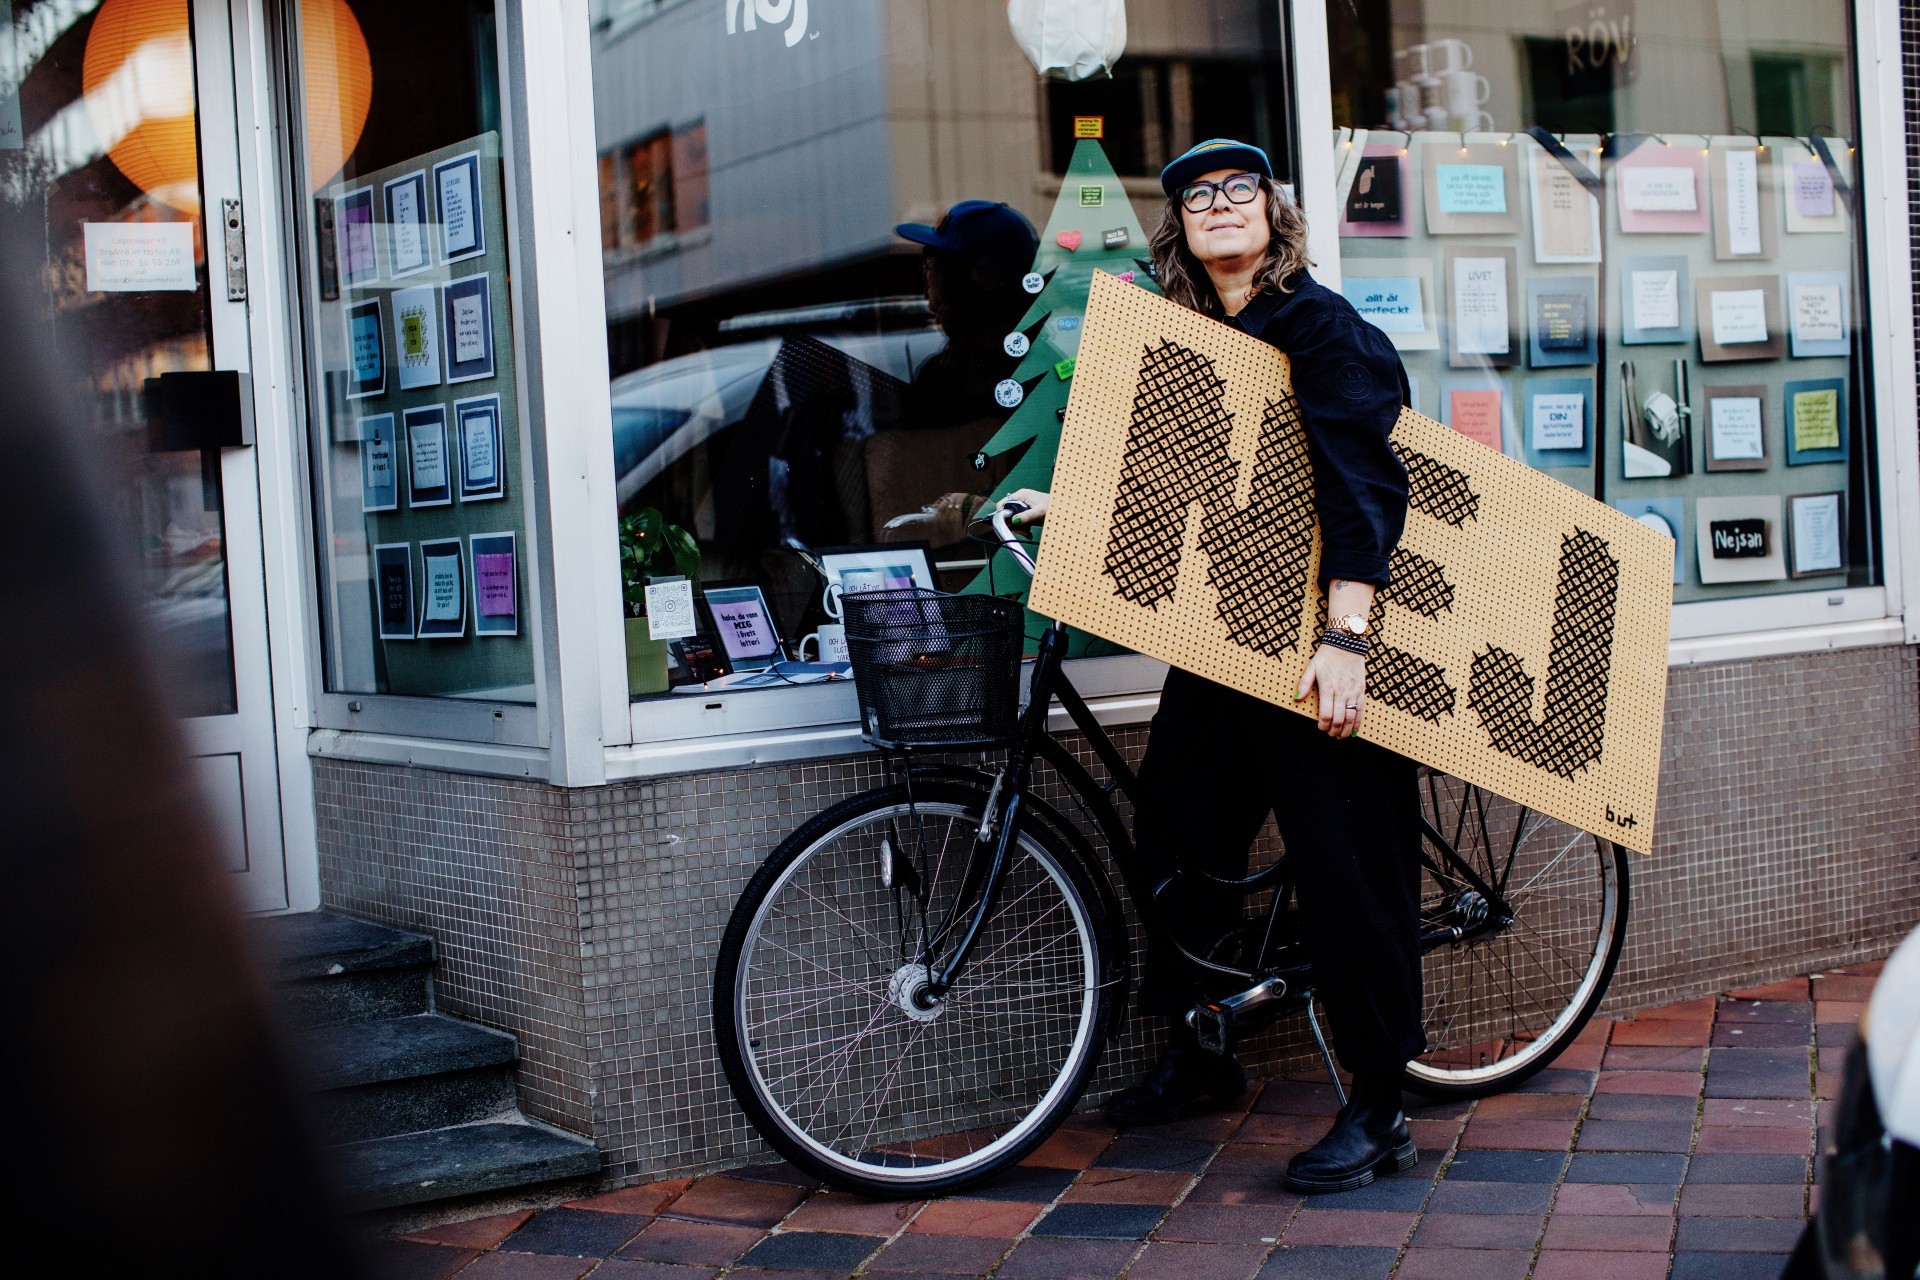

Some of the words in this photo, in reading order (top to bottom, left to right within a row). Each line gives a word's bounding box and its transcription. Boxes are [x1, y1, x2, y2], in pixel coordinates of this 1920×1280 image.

[1566, 8, 1630, 76] RÖV
[1468, 271, 1492, 280] LIVET
[1365, 294, 1383, 302] allt
[1387, 292, 1398, 302] är
[1550, 412, 1567, 421] DIN
[1715, 527, 1763, 553] Nejsan
[738, 612, 745, 620] du
[734, 620, 752, 629] MIG
[740, 638, 760, 647] lotteri
[1605, 803, 1638, 829] but
